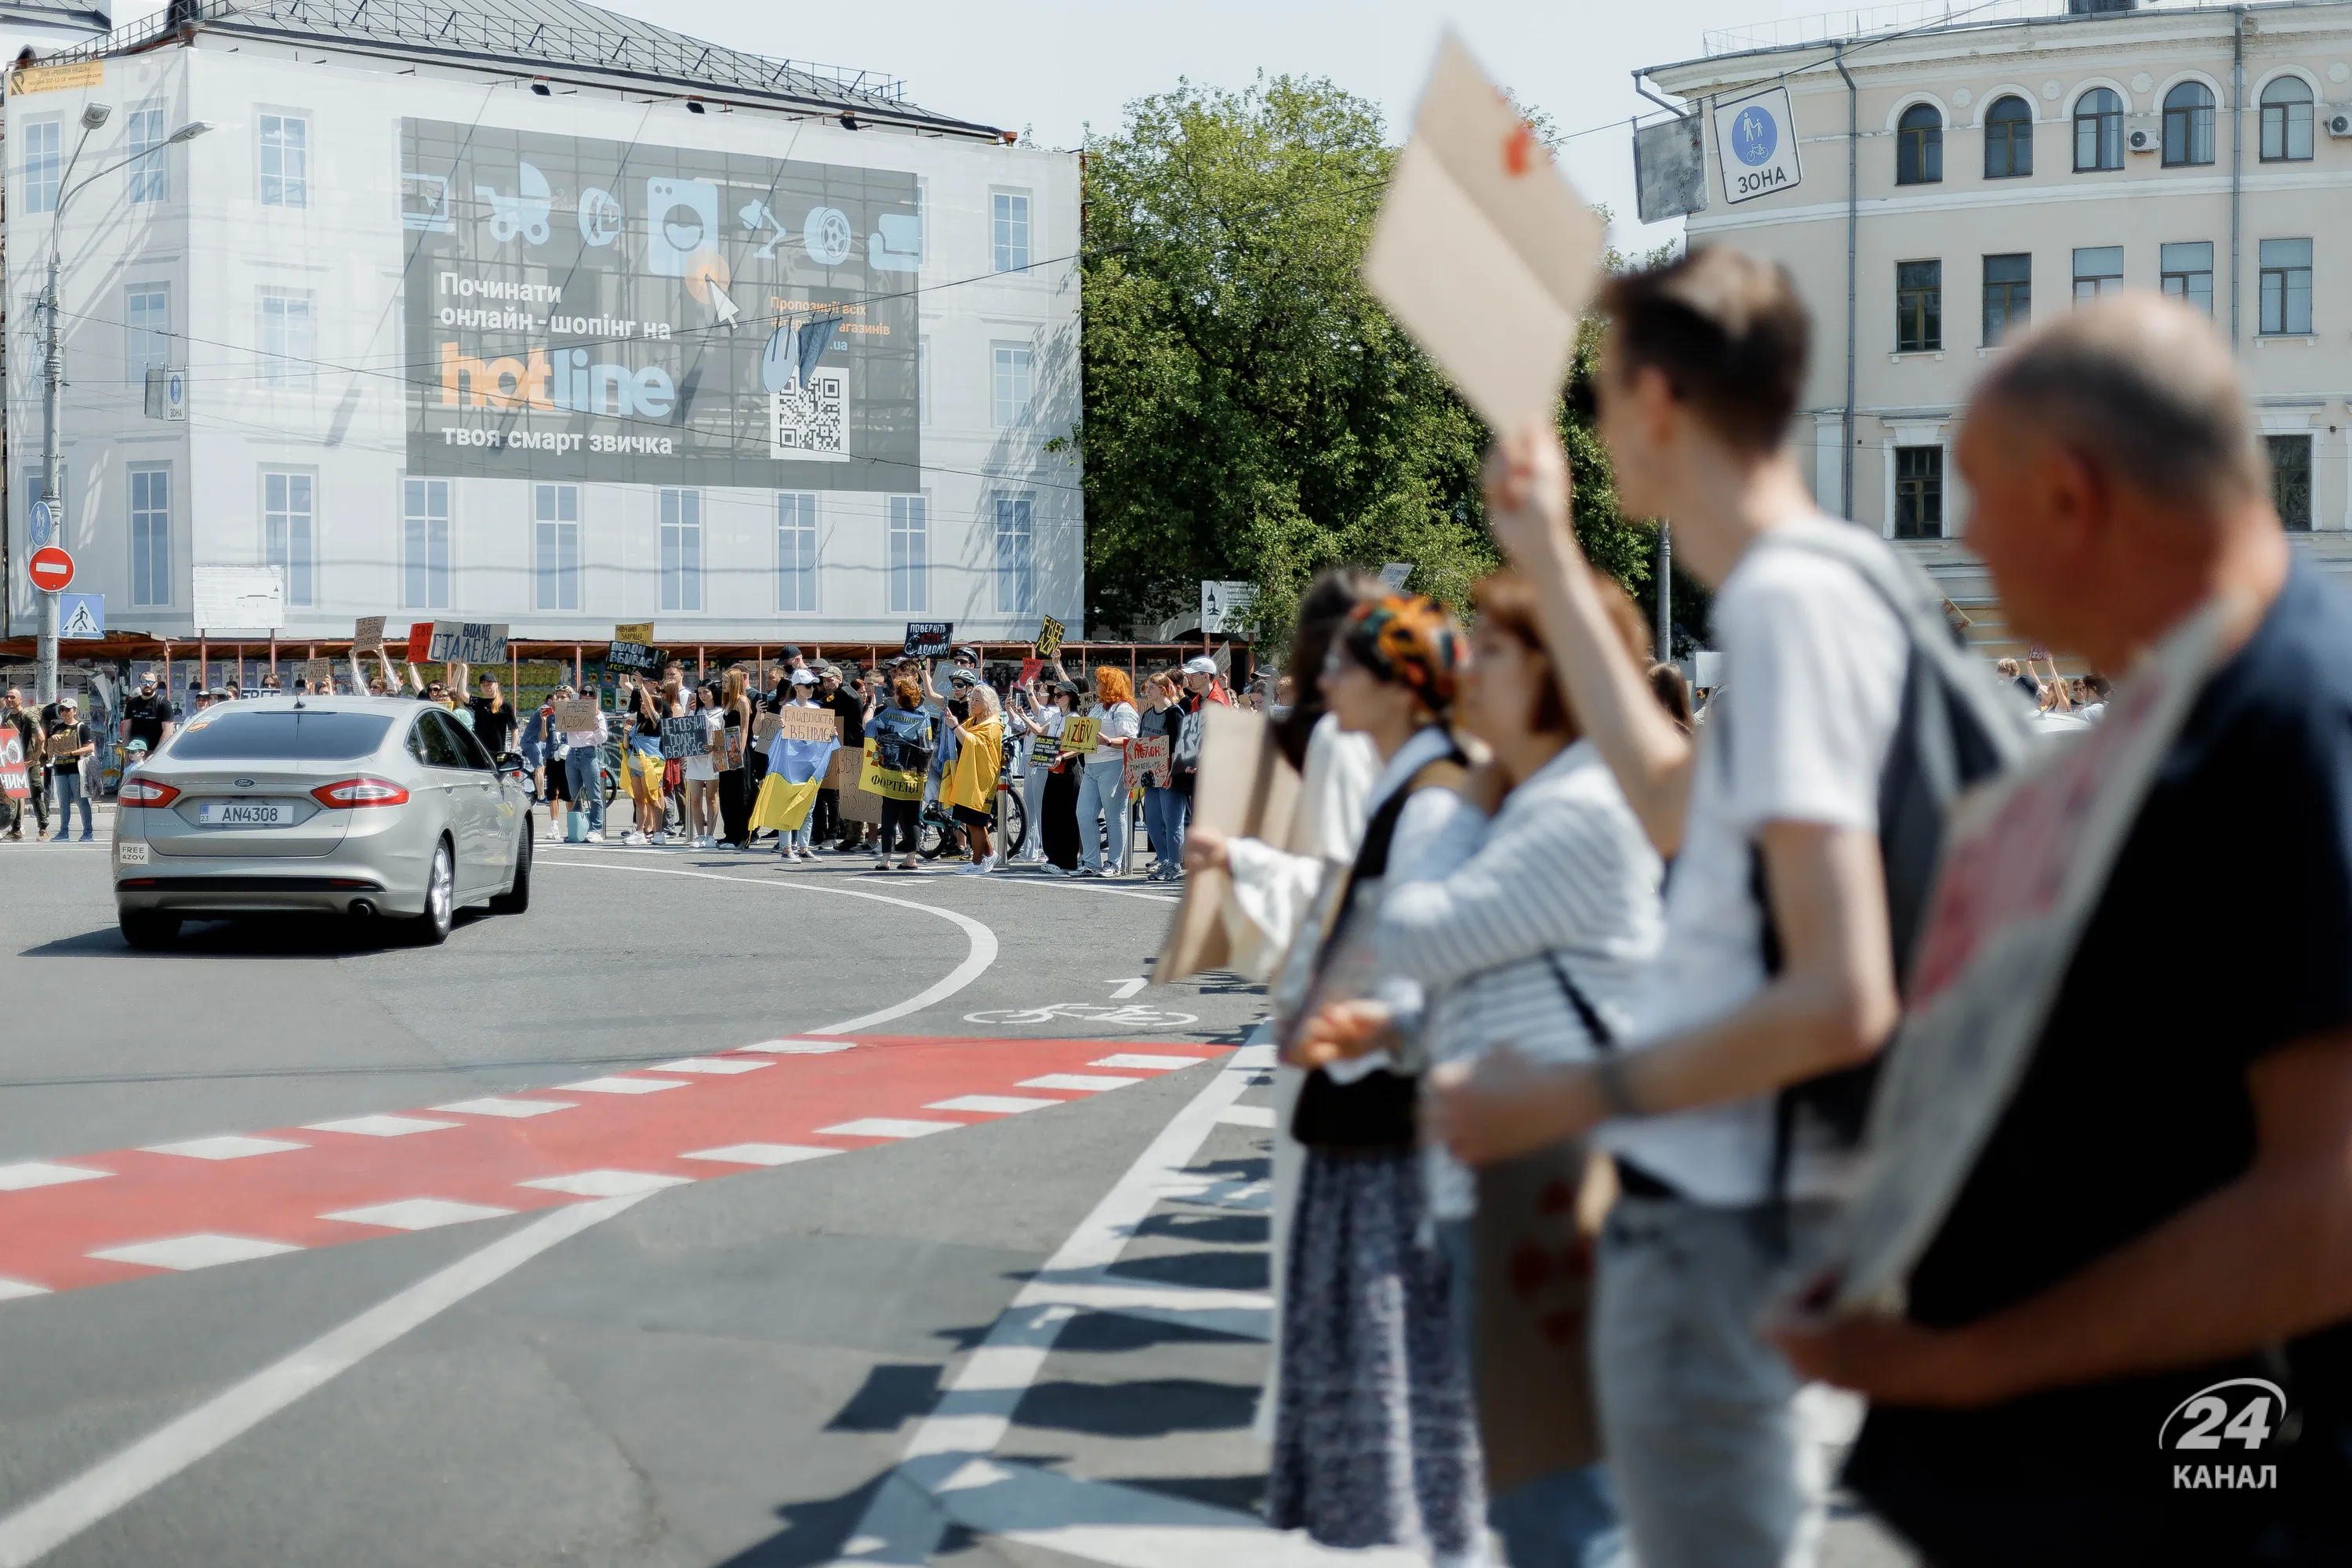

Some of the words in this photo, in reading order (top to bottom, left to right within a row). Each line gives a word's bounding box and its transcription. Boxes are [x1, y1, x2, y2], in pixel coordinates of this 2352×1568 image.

[1737, 166, 1788, 194] ЗОНА
[441, 271, 561, 303] Починати
[842, 303, 867, 316] всіх
[643, 321, 671, 340] на
[441, 342, 674, 418] hotline
[169, 407, 183, 419] ЗОНА
[441, 427, 501, 447] твоя
[508, 430, 583, 456] смарт
[589, 433, 673, 455] звичка
[358, 617, 378, 626] FREE
[1041, 615, 1065, 642] FREE
[357, 626, 383, 636] ZOVSTAL
[463, 623, 491, 639] ВОЛЮ
[431, 633, 508, 662] СТАЛЕВИМ
[612, 641, 646, 655] ПОЛОН
[1035, 633, 1059, 655] AZOV
[309, 659, 327, 668] FREE
[309, 668, 328, 677] AZOV
[567, 702, 590, 713] FREE
[561, 716, 586, 729] AZOV
[785, 710, 834, 724] БАЙДУЖІСТЬ
[1181, 711, 1204, 738] FRE
[661, 718, 674, 736] НЕ
[673, 716, 706, 732] МОВЧИ!
[789, 725, 831, 742] ВБИВАЄ
[670, 732, 695, 746] ПОЛОН
[665, 742, 705, 759] ВБИВАЄ
[840, 750, 863, 775] ЗБРО
[236, 779, 252, 787] Ford
[872, 775, 919, 795] ФОРТЕЦЯ
[843, 783, 877, 811] АЗОВ
[222, 808, 278, 822] AN4308
